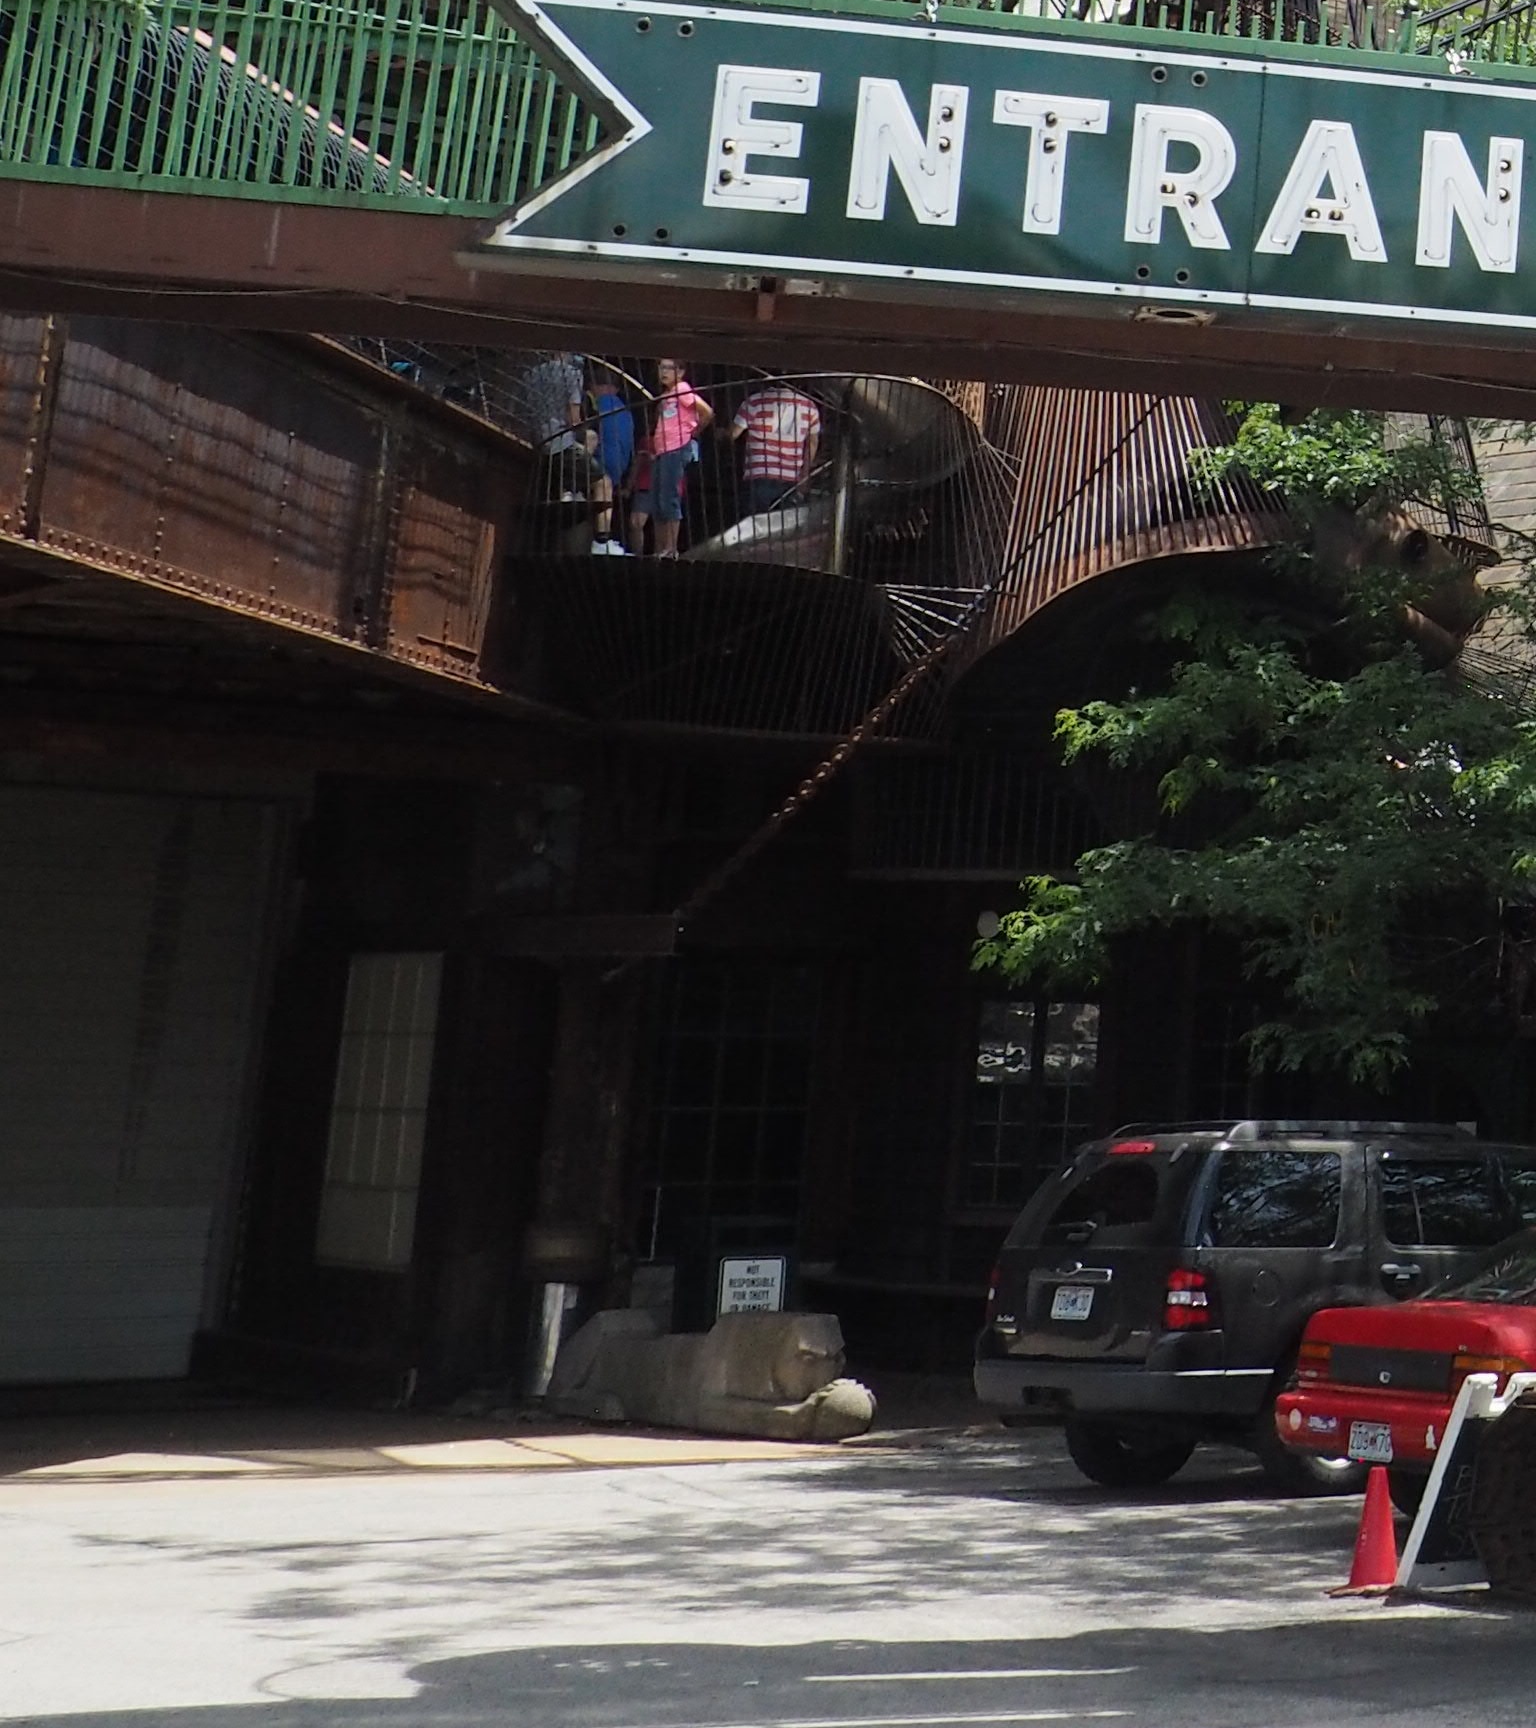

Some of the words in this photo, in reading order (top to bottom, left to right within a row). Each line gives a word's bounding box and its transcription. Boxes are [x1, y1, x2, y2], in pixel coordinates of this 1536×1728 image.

[746, 1265, 760, 1275] NOT
[729, 1277, 775, 1288] RESPONSIBLE
[733, 1290, 746, 1301] FOR
